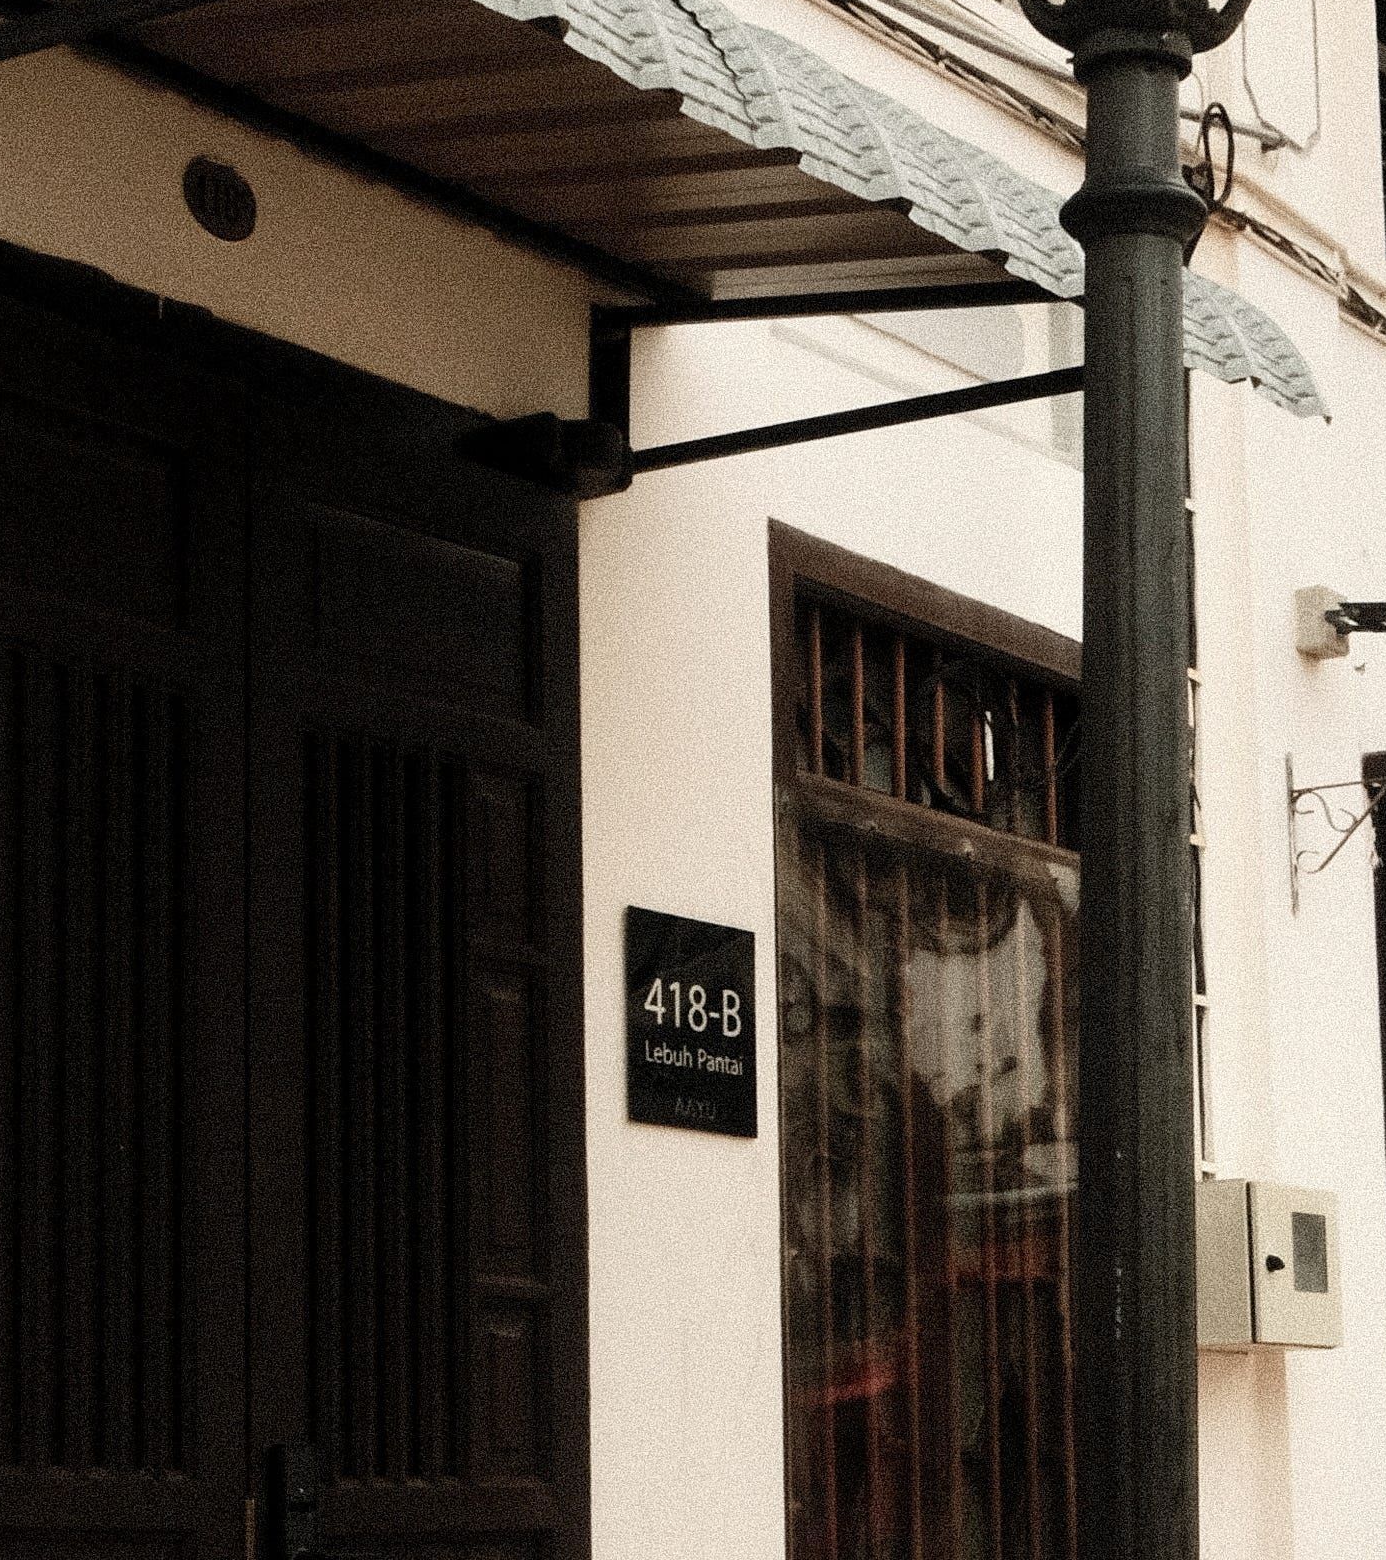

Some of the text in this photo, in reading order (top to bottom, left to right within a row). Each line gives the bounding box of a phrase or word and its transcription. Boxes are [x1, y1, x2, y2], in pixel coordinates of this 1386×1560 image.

[643, 977, 743, 1038] 418-B
[645, 1039, 743, 1076] Lebuh Pantai
